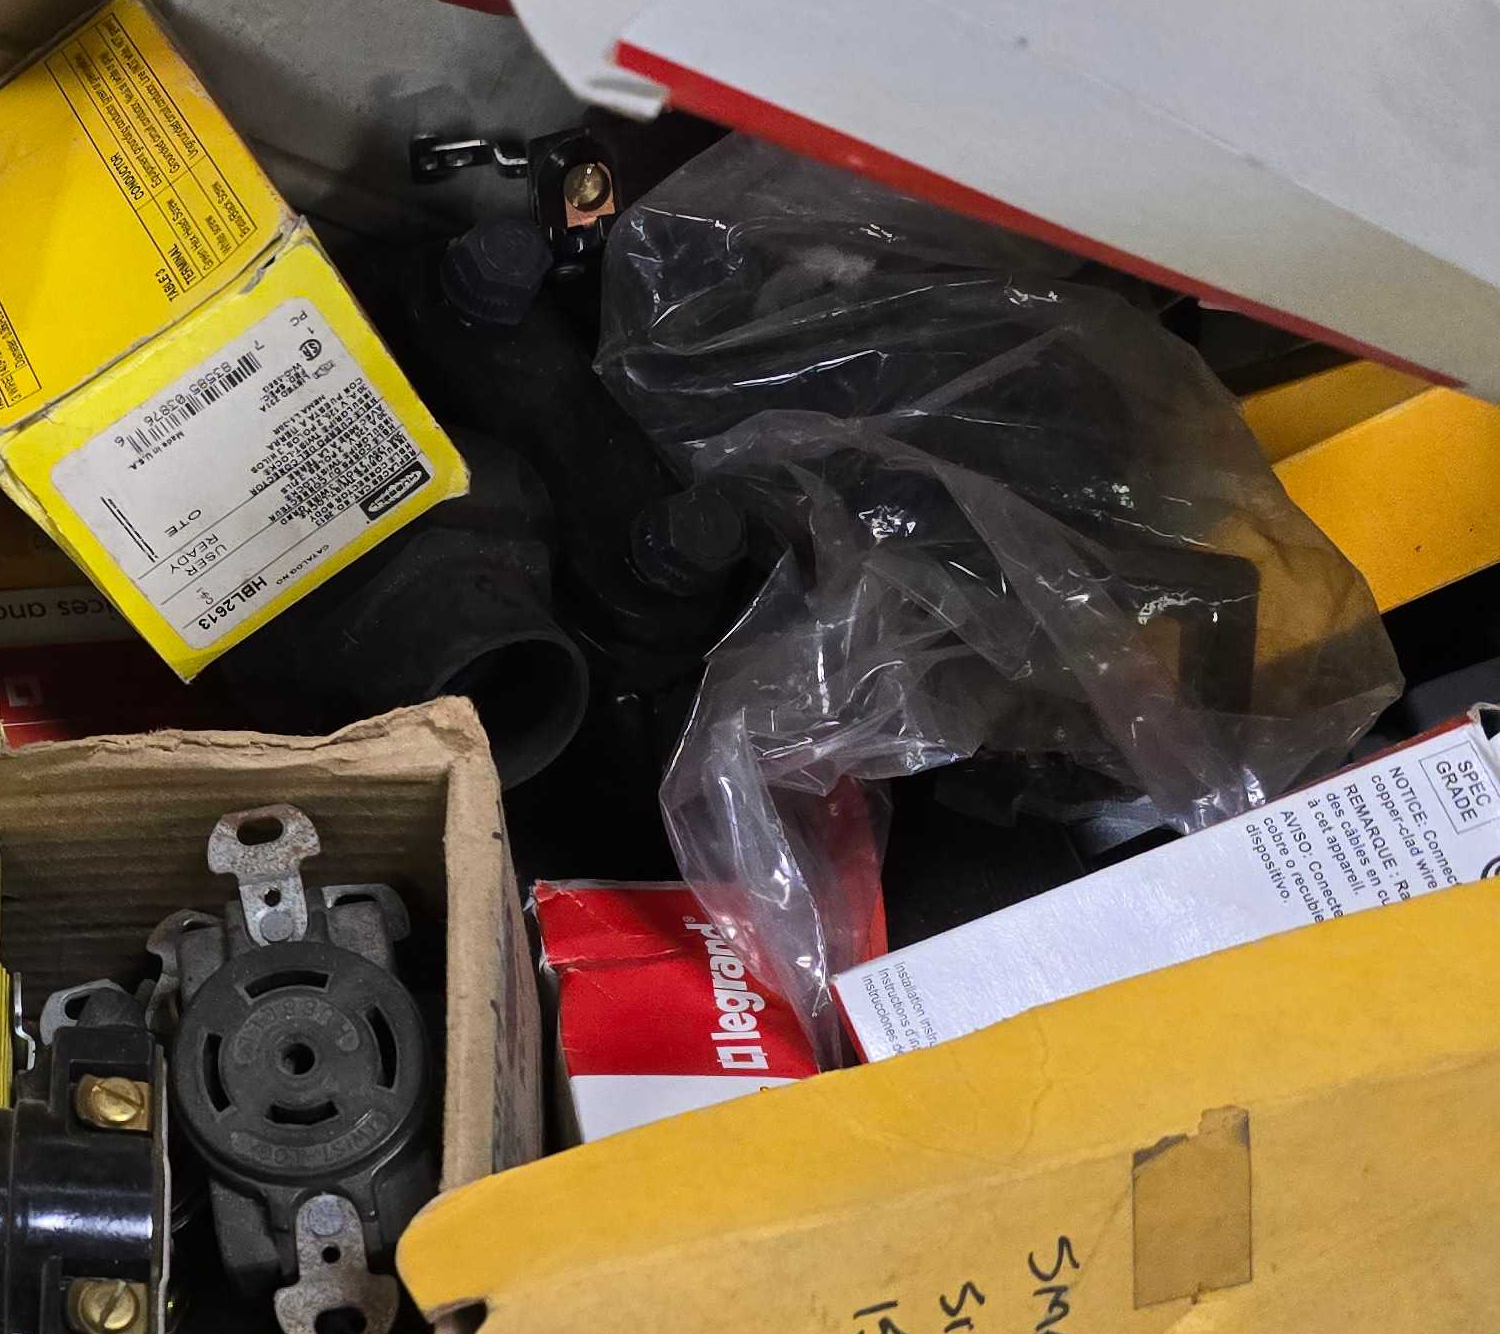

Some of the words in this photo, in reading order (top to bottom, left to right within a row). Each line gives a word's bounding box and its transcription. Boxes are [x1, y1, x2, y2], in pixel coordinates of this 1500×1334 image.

[107, 148, 146, 203] CONDUCTOR
[156, 272, 182, 303] TABLE
[164, 240, 199, 287] TERMINAL
[164, 531, 220, 575] READY
[182, 541, 229, 578] USER
[194, 573, 269, 633] HBL2613
[1387, 763, 1430, 829] NOTICE:
[1433, 757, 1478, 824] GRADE
[1455, 756, 1493, 809] SPEC
[1261, 814, 1292, 858] cobre
[1278, 806, 1316, 860] AVISO:
[1312, 808, 1333, 834] cet
[1323, 832, 1367, 898] appareil.
[1323, 789, 1348, 819] des
[1364, 866, 1383, 887] en
[1341, 781, 1398, 872] REMARQUE
[1367, 771, 1423, 859] copper-clad
[1414, 856, 1440, 891] wire
[1240, 820, 1296, 905] dispositivo.
